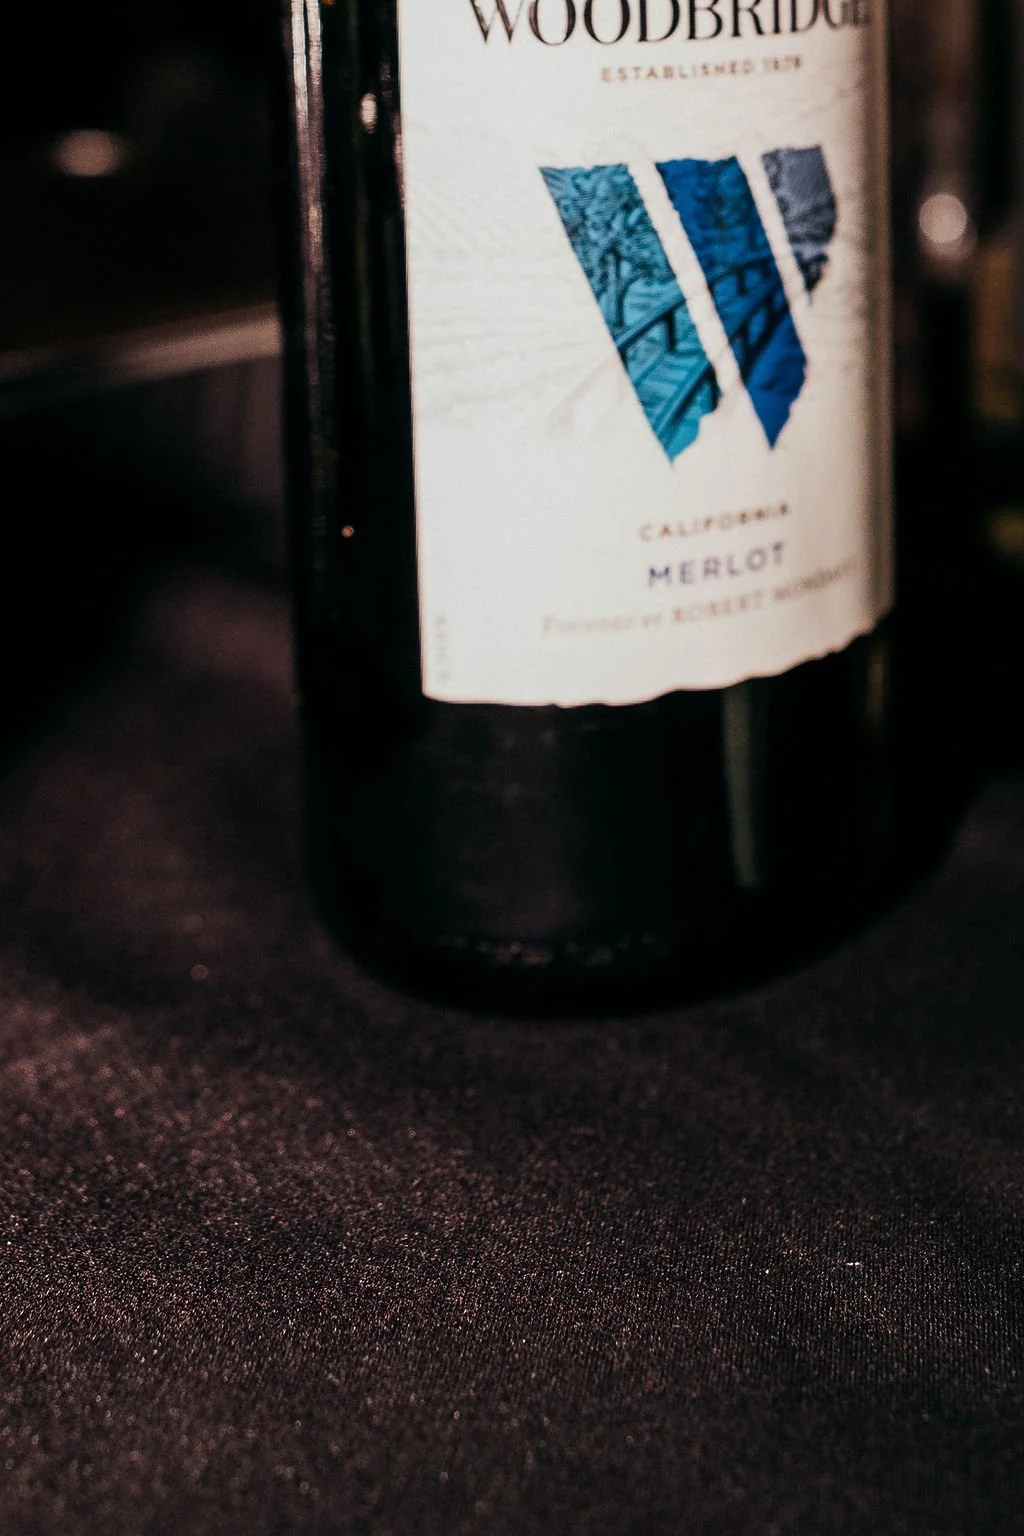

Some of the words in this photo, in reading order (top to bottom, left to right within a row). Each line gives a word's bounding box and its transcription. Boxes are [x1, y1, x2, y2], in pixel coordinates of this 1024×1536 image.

[600, 57, 755, 83] ESTABLISHED
[638, 502, 791, 541] CALIFORNIA
[647, 542, 787, 588] MERLOT
